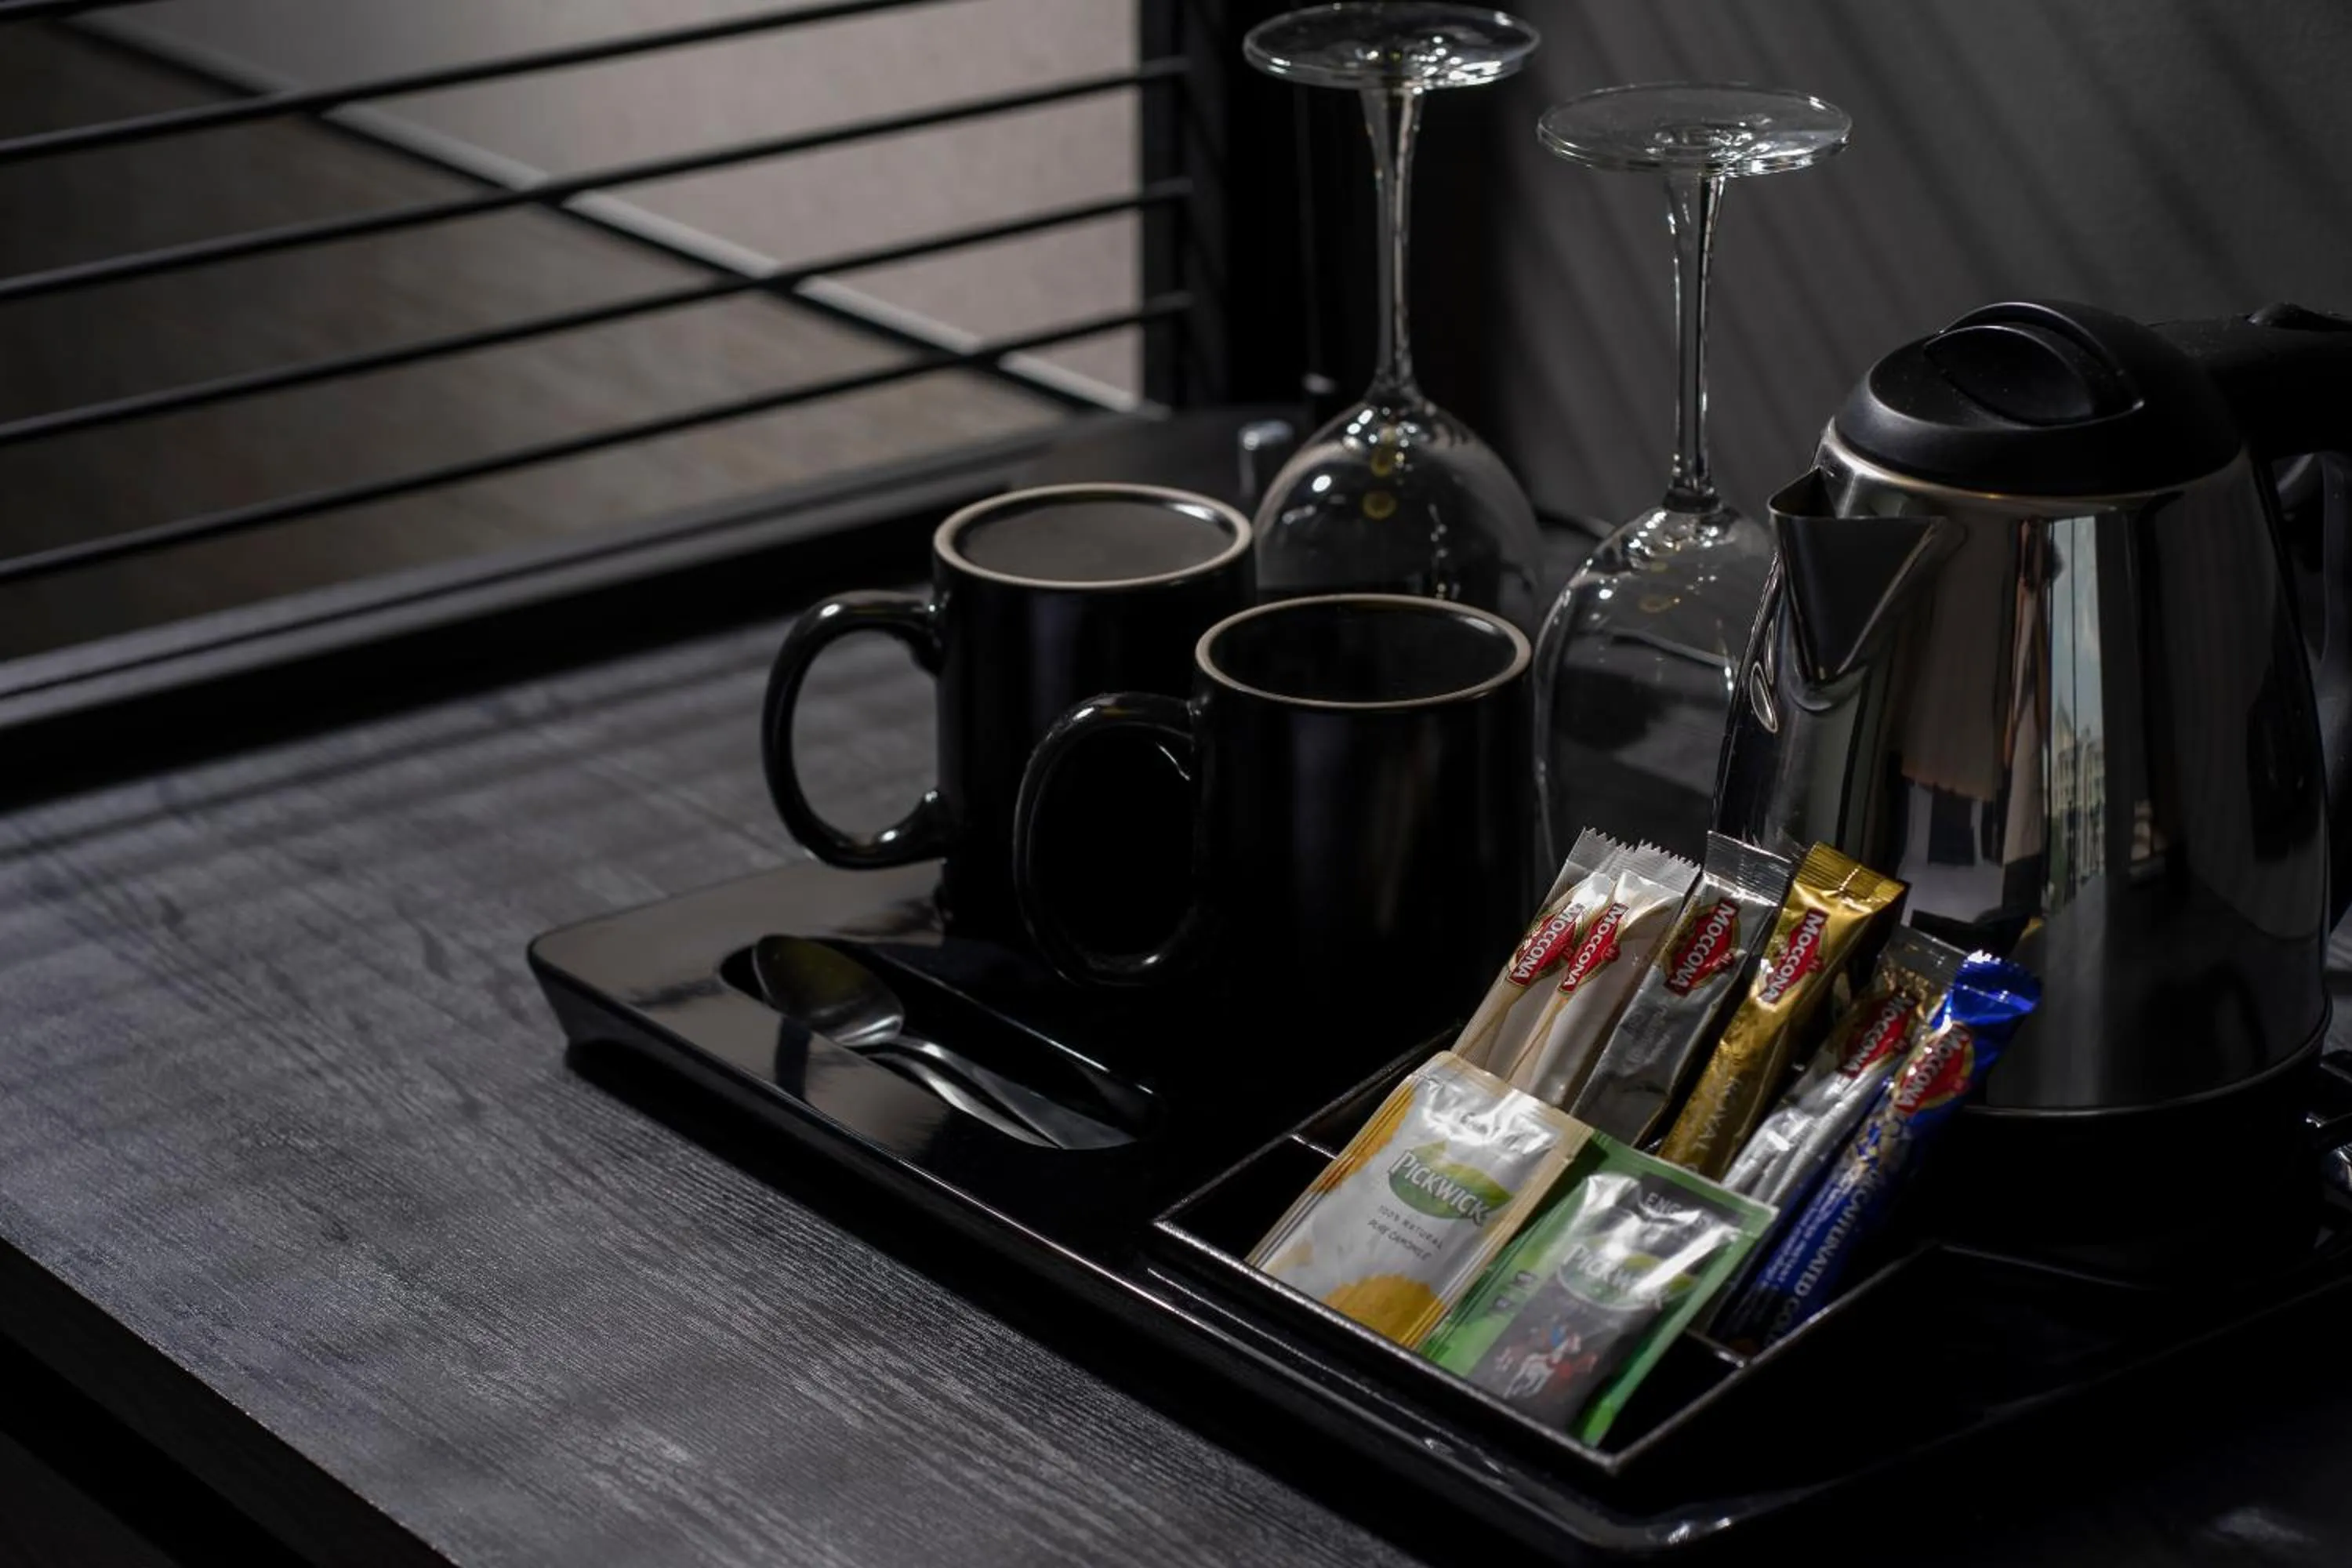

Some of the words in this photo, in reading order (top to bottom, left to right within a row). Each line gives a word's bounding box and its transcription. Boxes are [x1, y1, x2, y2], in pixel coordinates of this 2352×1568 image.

[1514, 903, 1584, 979] MOCCONA
[1563, 904, 1627, 986] MOCCONA
[1671, 902, 1735, 989] MOCCONA
[1762, 911, 1825, 1000] MOCCONA
[1842, 994, 1916, 1072] MOCCONA
[1897, 1025, 1971, 1106] MOCCONA
[1388, 1149, 1488, 1225] PICKWICK
